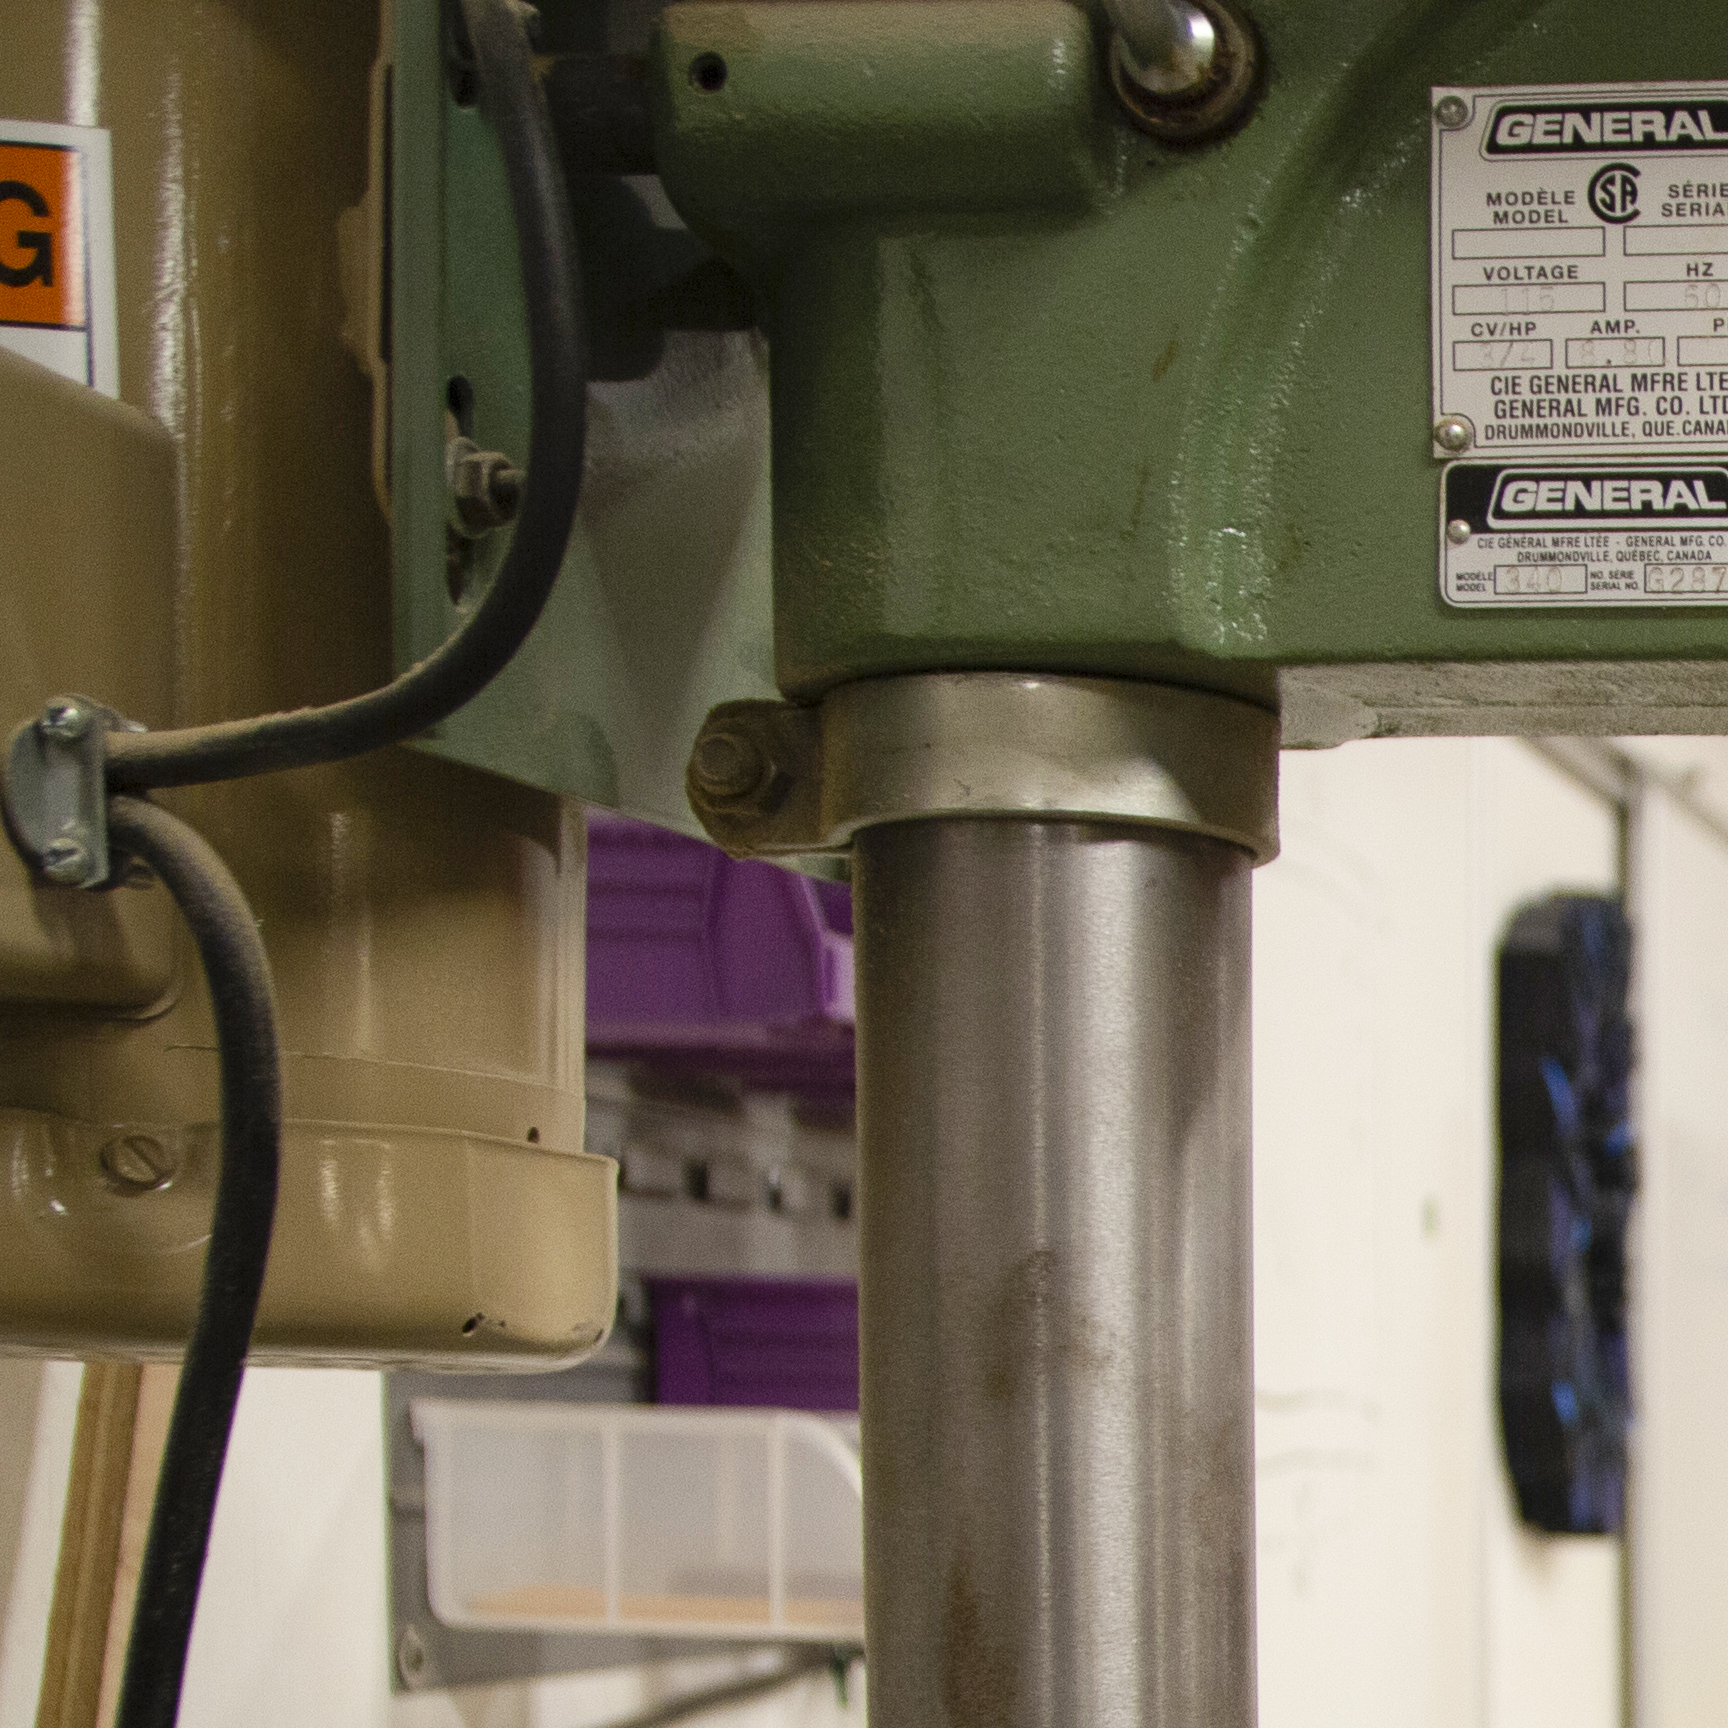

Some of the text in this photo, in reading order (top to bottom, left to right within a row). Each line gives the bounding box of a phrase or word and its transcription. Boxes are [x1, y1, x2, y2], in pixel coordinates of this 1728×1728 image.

[1486, 186, 1575, 207] MODÈLE
[1493, 209, 1569, 225] MODEL
[1483, 265, 1579, 282] VOLTAGE
[1686, 262, 1714, 278] HZ
[1471, 322, 1537, 337] CV/HP
[1590, 319, 1640, 335] AMP.
[1490, 375, 1522, 395] CIE
[1529, 373, 1624, 395] GENERAL
[1631, 372, 1689, 393] MFRE
[1494, 397, 1588, 419] GENERAL
[1595, 396, 1648, 417] MFG.
[1656, 395, 1690, 416] CO.
[1484, 421, 1636, 440] DRUMMONDVILLE,
[1500, 479, 1727, 513] GENERAL
[1477, 537, 1494, 549] CIE
[1551, 535, 1581, 548] MFRE
[1626, 535, 1676, 547] GENERAL
[1517, 550, 1613, 563] DRUMMONDVILLE,
[1667, 550, 1713, 561] CANADA
[1456, 583, 1487, 592] MODEL
